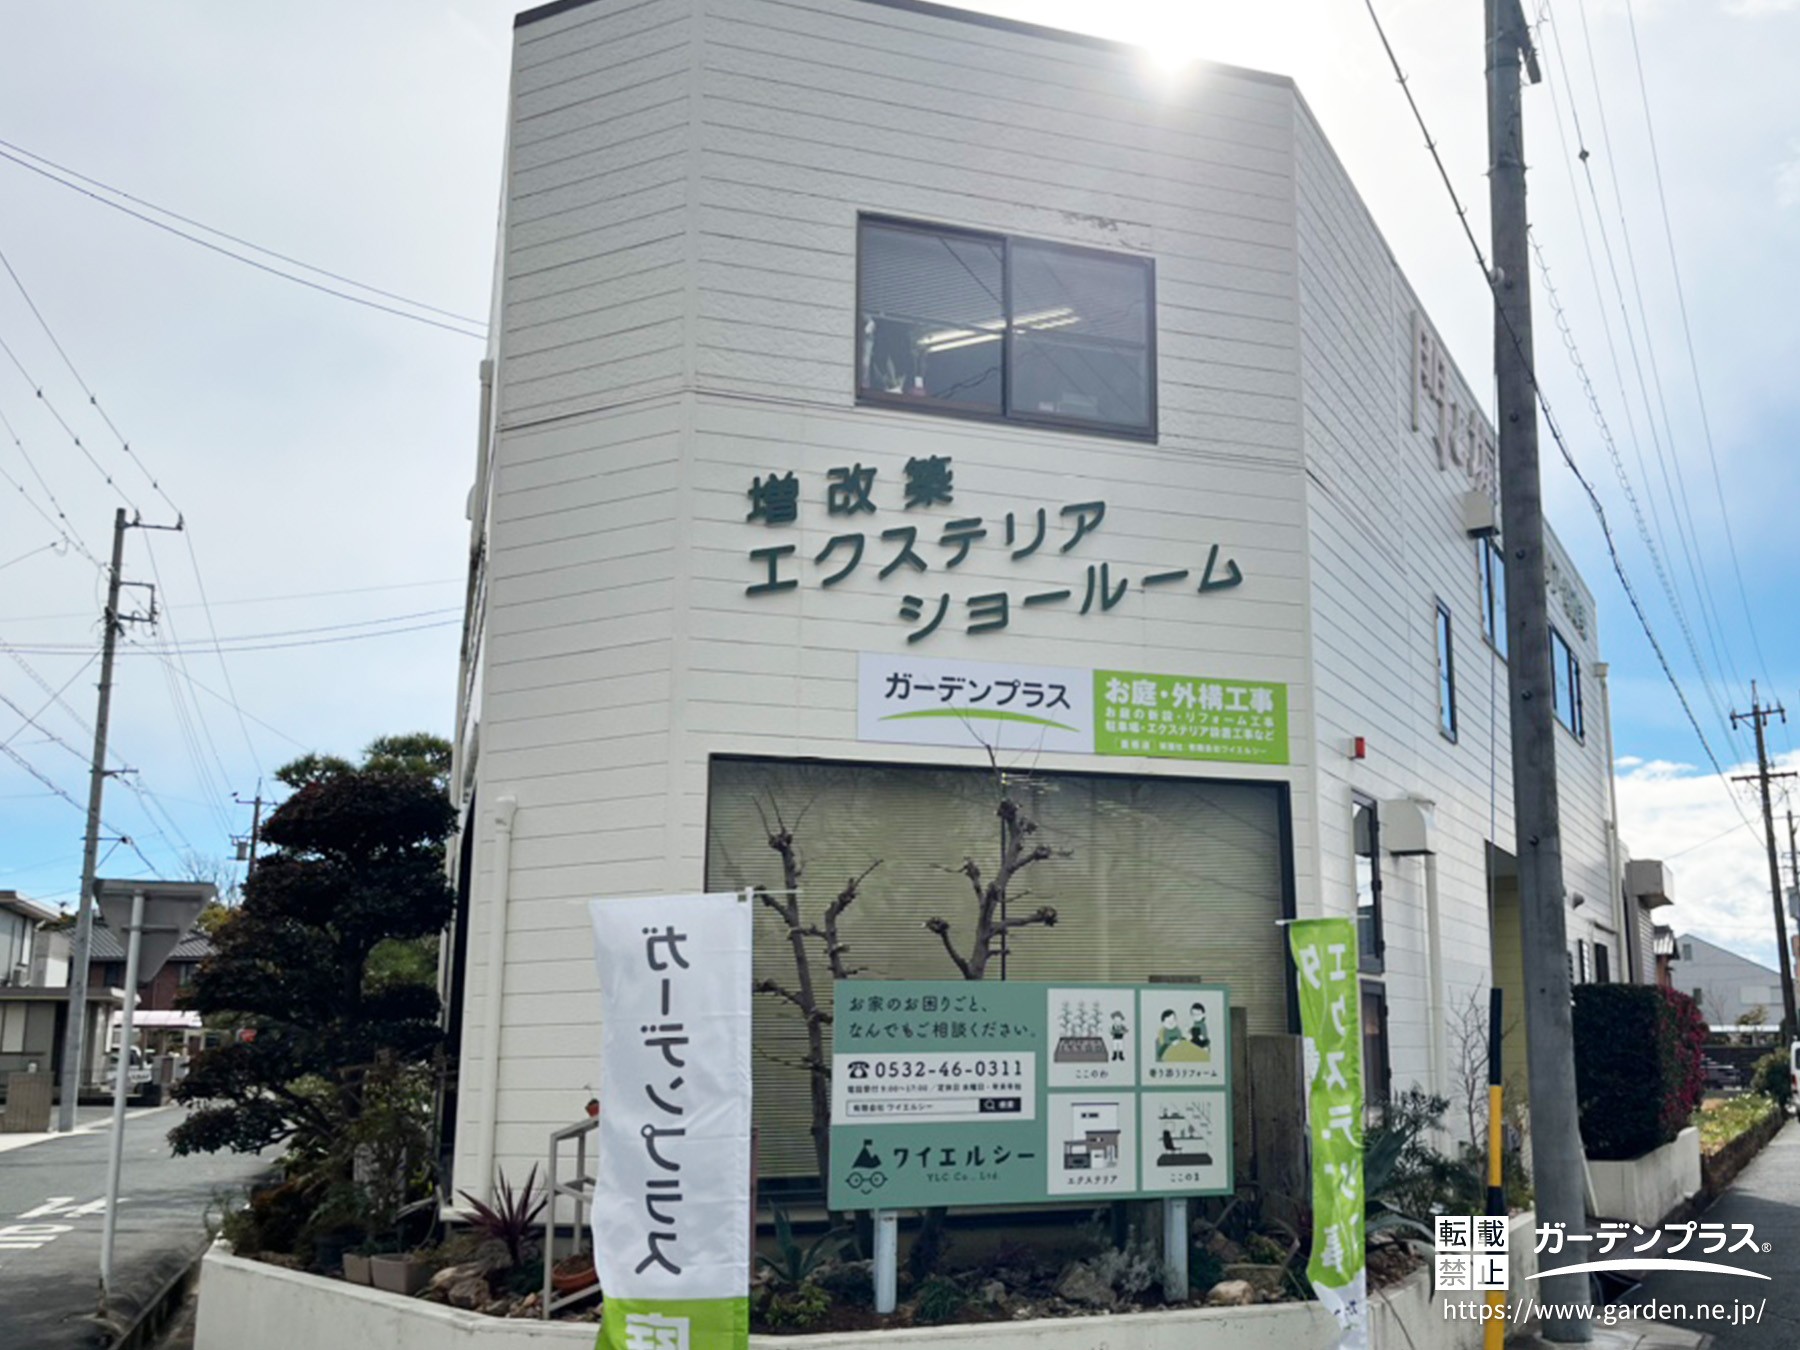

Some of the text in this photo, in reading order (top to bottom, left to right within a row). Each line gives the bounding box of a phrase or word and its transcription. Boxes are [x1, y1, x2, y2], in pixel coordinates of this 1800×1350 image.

[746, 455, 954, 524] 増改築
[745, 501, 1106, 597] エクステリア
[900, 544, 1244, 644] ショールーム
[884, 672, 1072, 710] ガーデンプラス
[1104, 677, 1274, 714] お庭・外構工事
[849, 995, 988, 1013] お家のお困りごと、
[849, 1021, 1037, 1039] なんでもご相談ください。
[875, 1060, 1022, 1078] 0532-46-0311
[893, 1145, 1036, 1169] ワイエルシー
